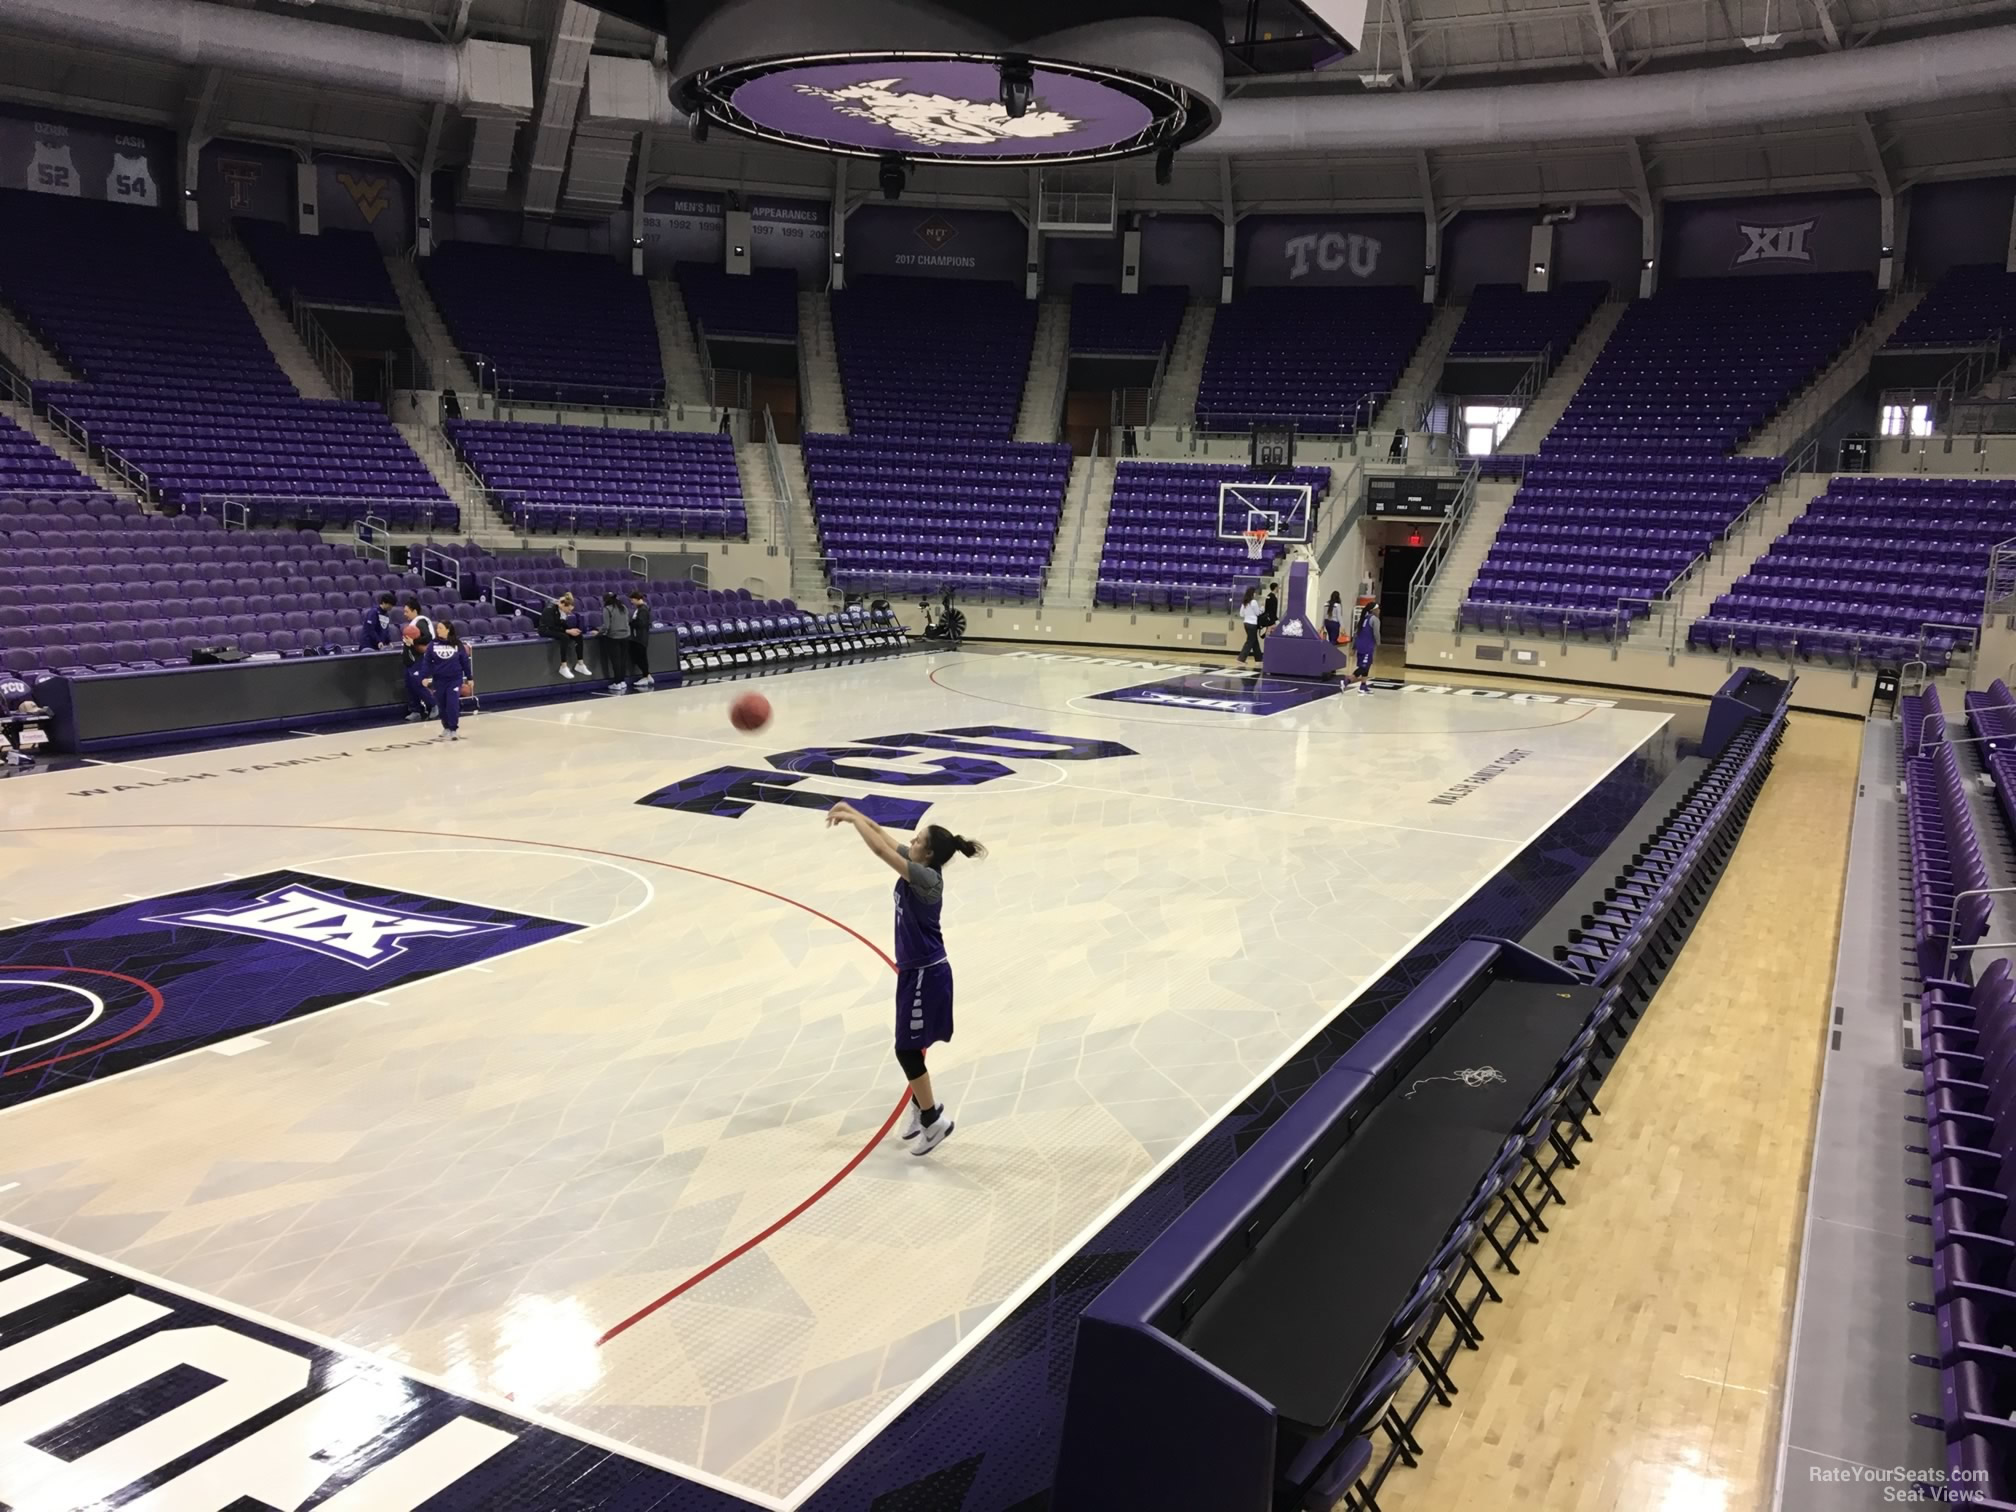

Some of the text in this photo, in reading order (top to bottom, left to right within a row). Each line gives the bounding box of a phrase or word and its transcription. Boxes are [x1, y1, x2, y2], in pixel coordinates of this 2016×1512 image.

[115, 134, 146, 149] CASH
[38, 163, 69, 187] 52
[117, 174, 147, 197] 54
[674, 201, 818, 221] MEN'S NIT APPEARANCES
[669, 219, 692, 230] 1992
[752, 225, 774, 235] 1997
[809, 230, 828, 240] 200
[1737, 221, 1815, 263] XII
[895, 254, 976, 267] 2017 CHAMPIONS
[1285, 232, 1382, 279] TCU
[1, 682, 25, 695] TCU
[66, 772, 220, 797] WALSH
[228, 751, 354, 774] FAMILY
[634, 725, 1141, 831] TCU
[1427, 784, 1480, 805] WALSH
